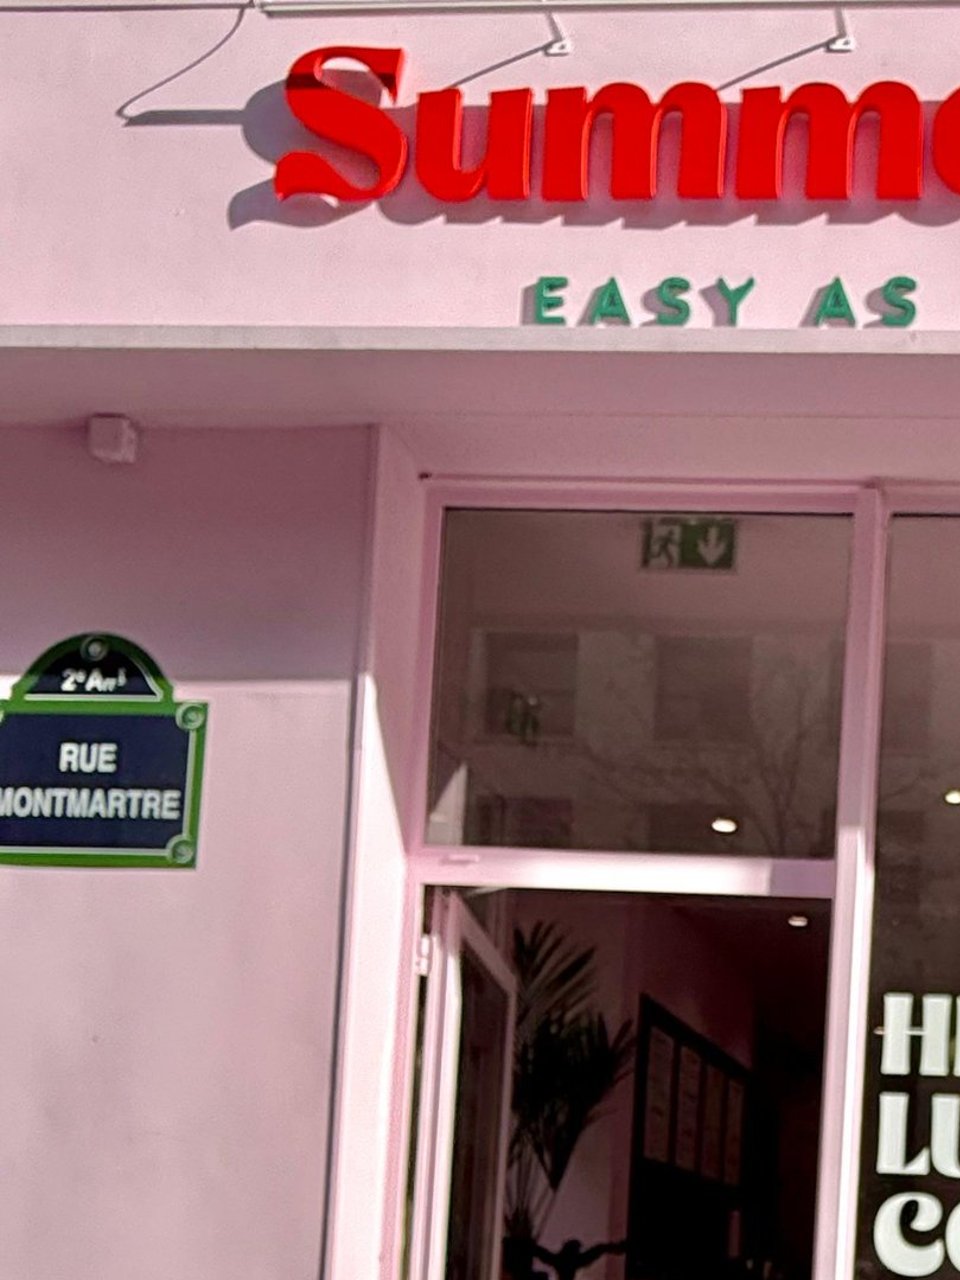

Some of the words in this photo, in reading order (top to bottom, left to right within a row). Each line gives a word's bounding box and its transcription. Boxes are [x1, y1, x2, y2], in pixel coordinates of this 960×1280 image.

[534, 276, 755, 326] EASY
[814, 277, 918, 328] AS
[59, 742, 118, 773] RUE
